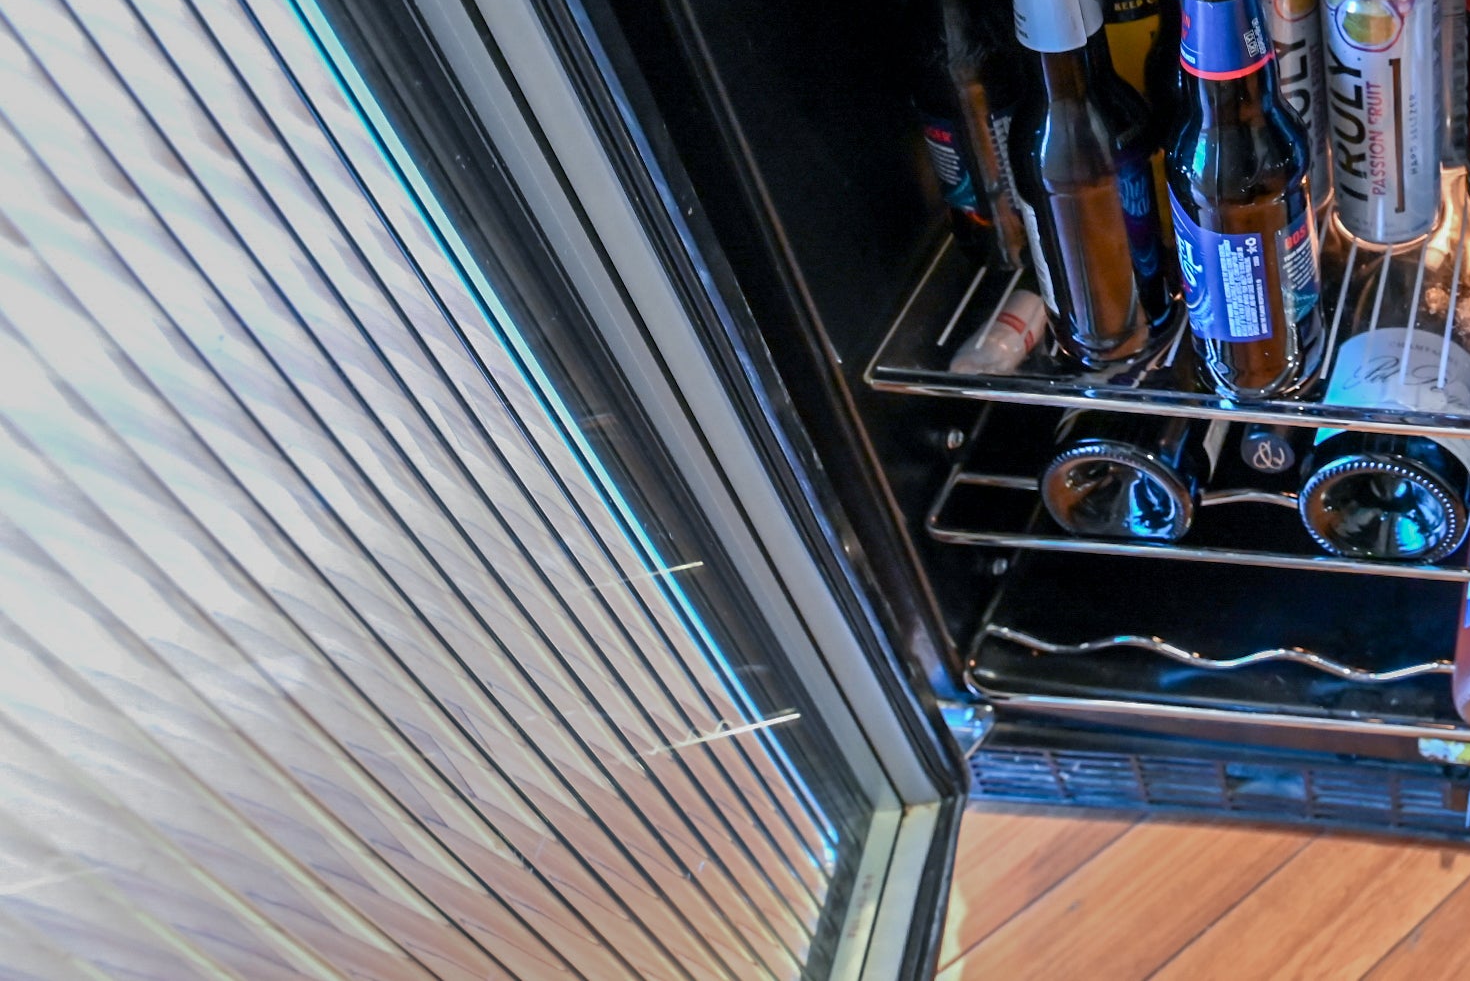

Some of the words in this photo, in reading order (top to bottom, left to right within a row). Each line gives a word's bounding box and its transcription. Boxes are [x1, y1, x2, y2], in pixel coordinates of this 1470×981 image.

[1113, 0, 1142, 12] KEEP
[1326, 45, 1368, 202] TRULY
[1366, 81, 1383, 125] FRUIT
[1368, 130, 1386, 195] PASSION
